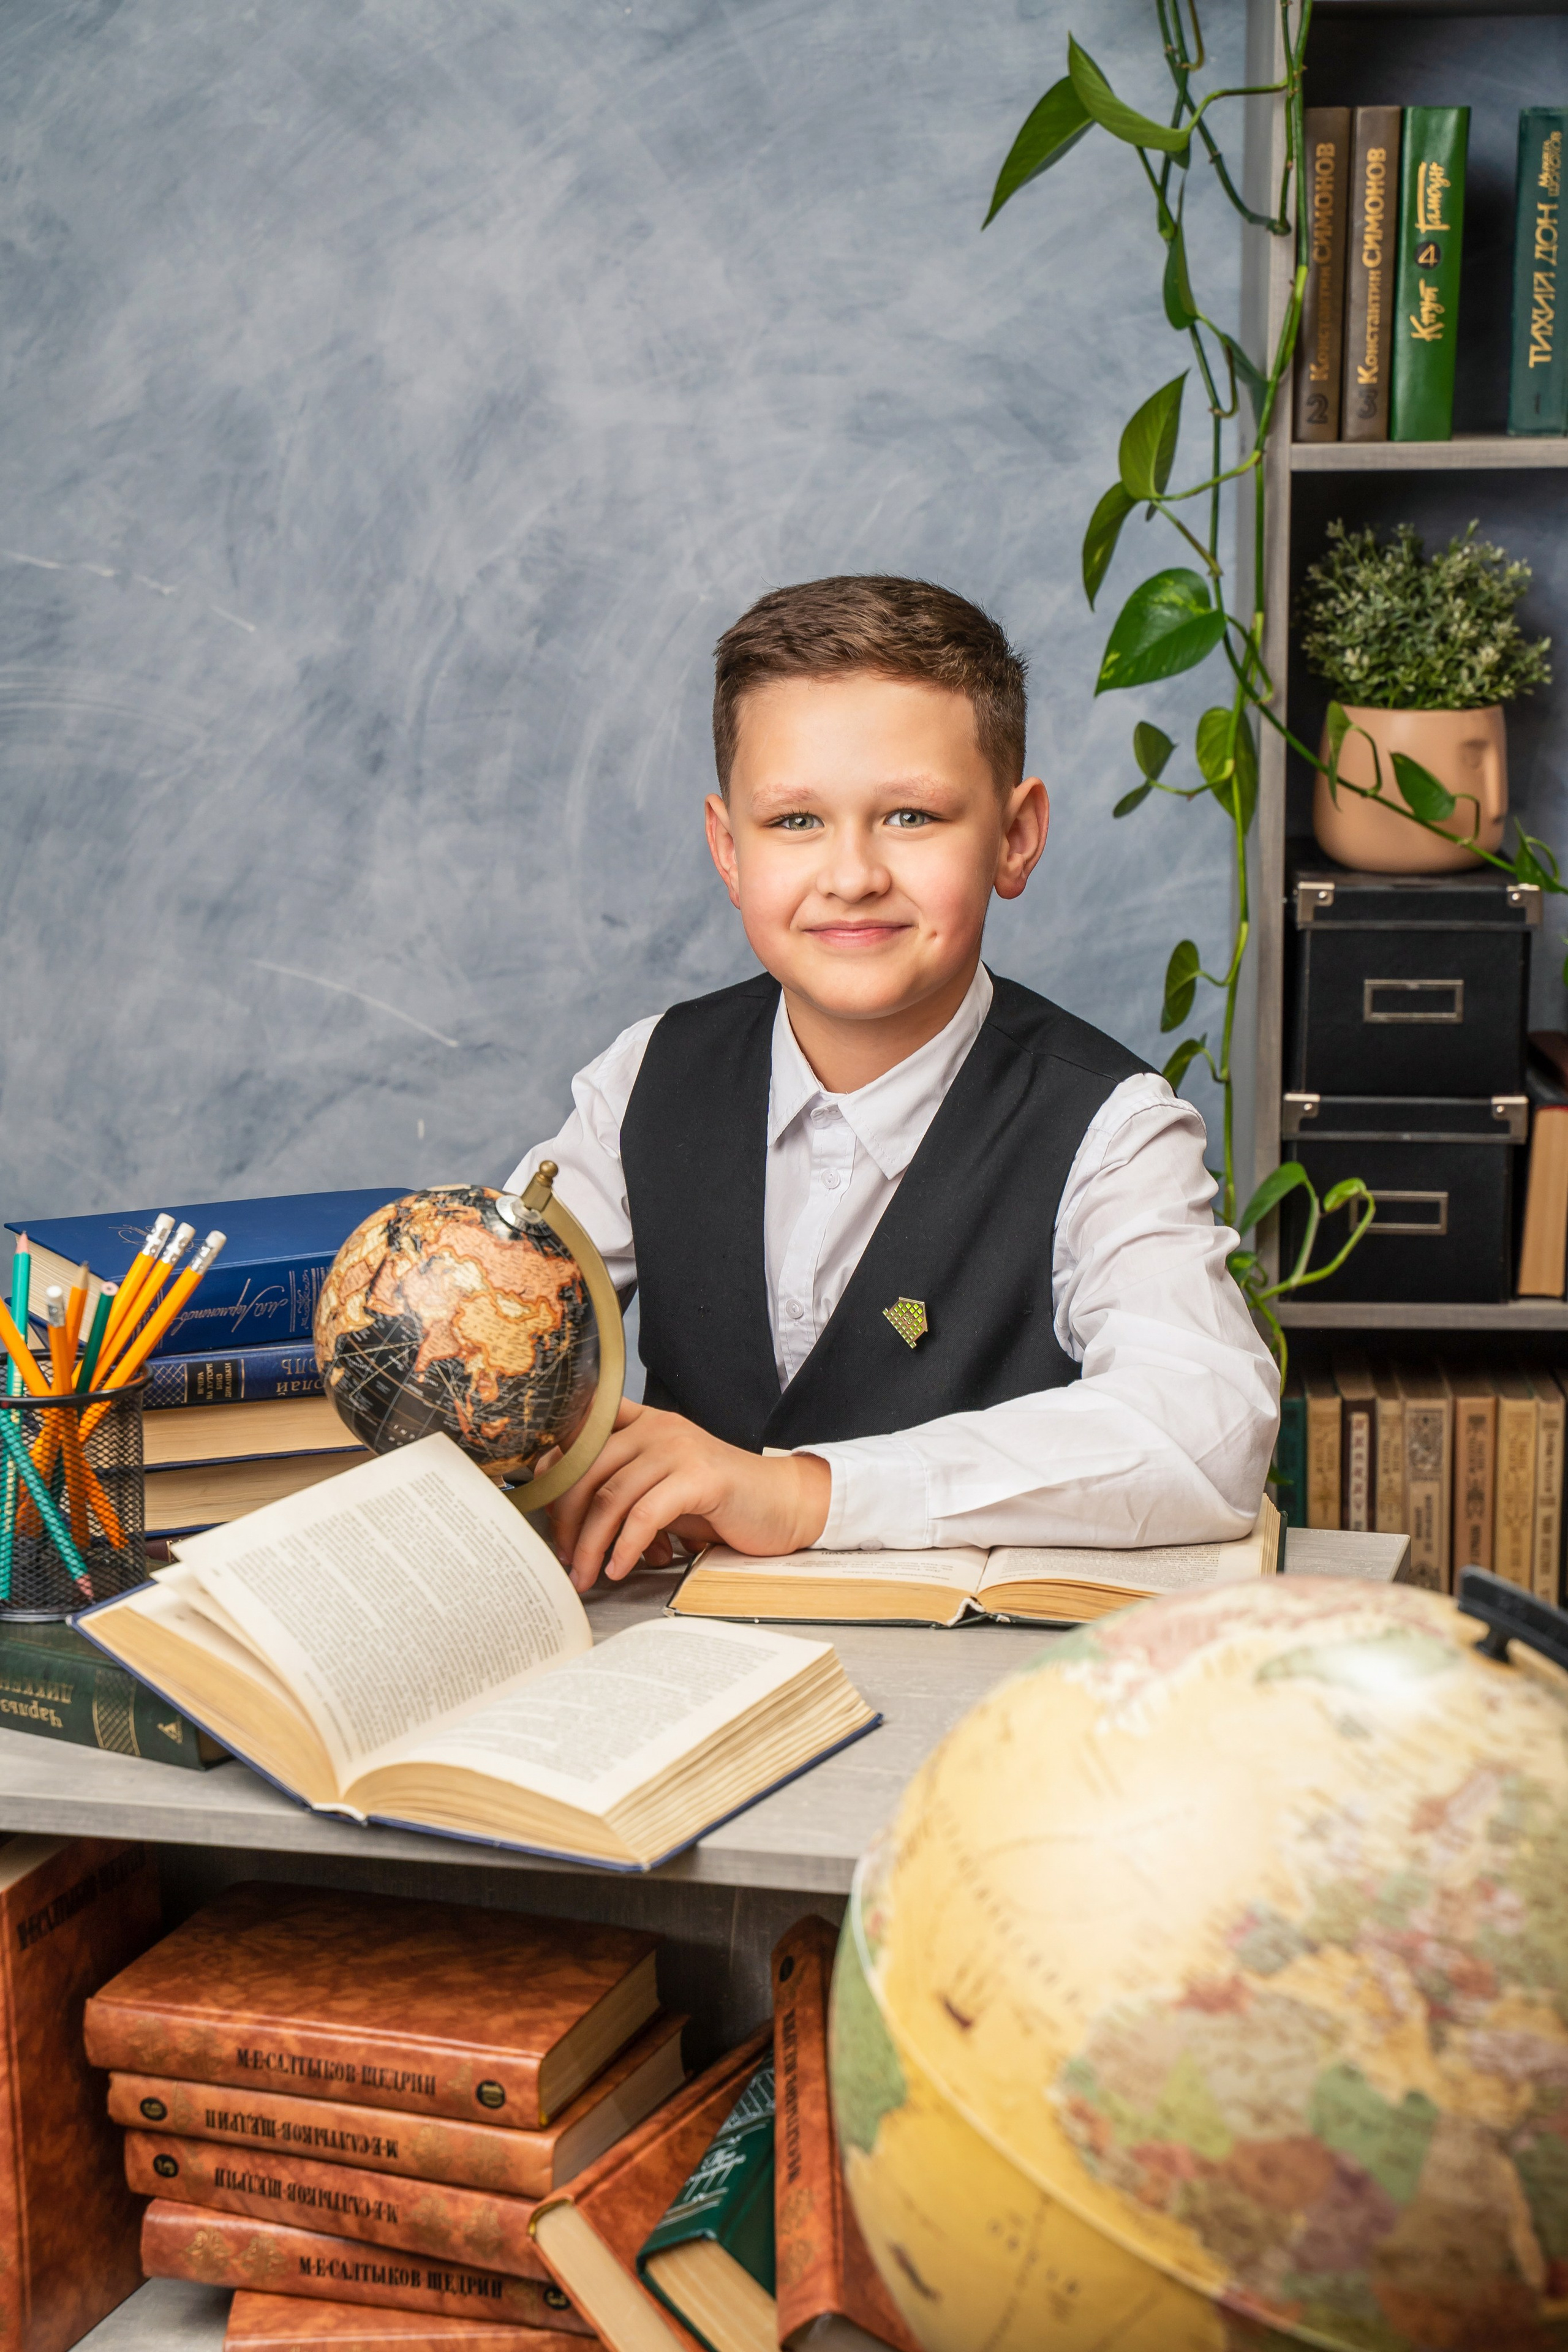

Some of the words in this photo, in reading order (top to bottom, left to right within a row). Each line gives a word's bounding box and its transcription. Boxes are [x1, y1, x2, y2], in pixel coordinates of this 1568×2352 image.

[1312, 142, 1336, 264] СИМОНОВ
[1362, 147, 1387, 268] СИМОНОВ
[1535, 202, 1559, 267] ДОН
[1418, 244, 1438, 266] 4
[1305, 393, 1329, 424] 2
[1356, 388, 1379, 419] 3
[206, 1390, 213, 1400] НА
[157, 2158, 176, 2176] 5
